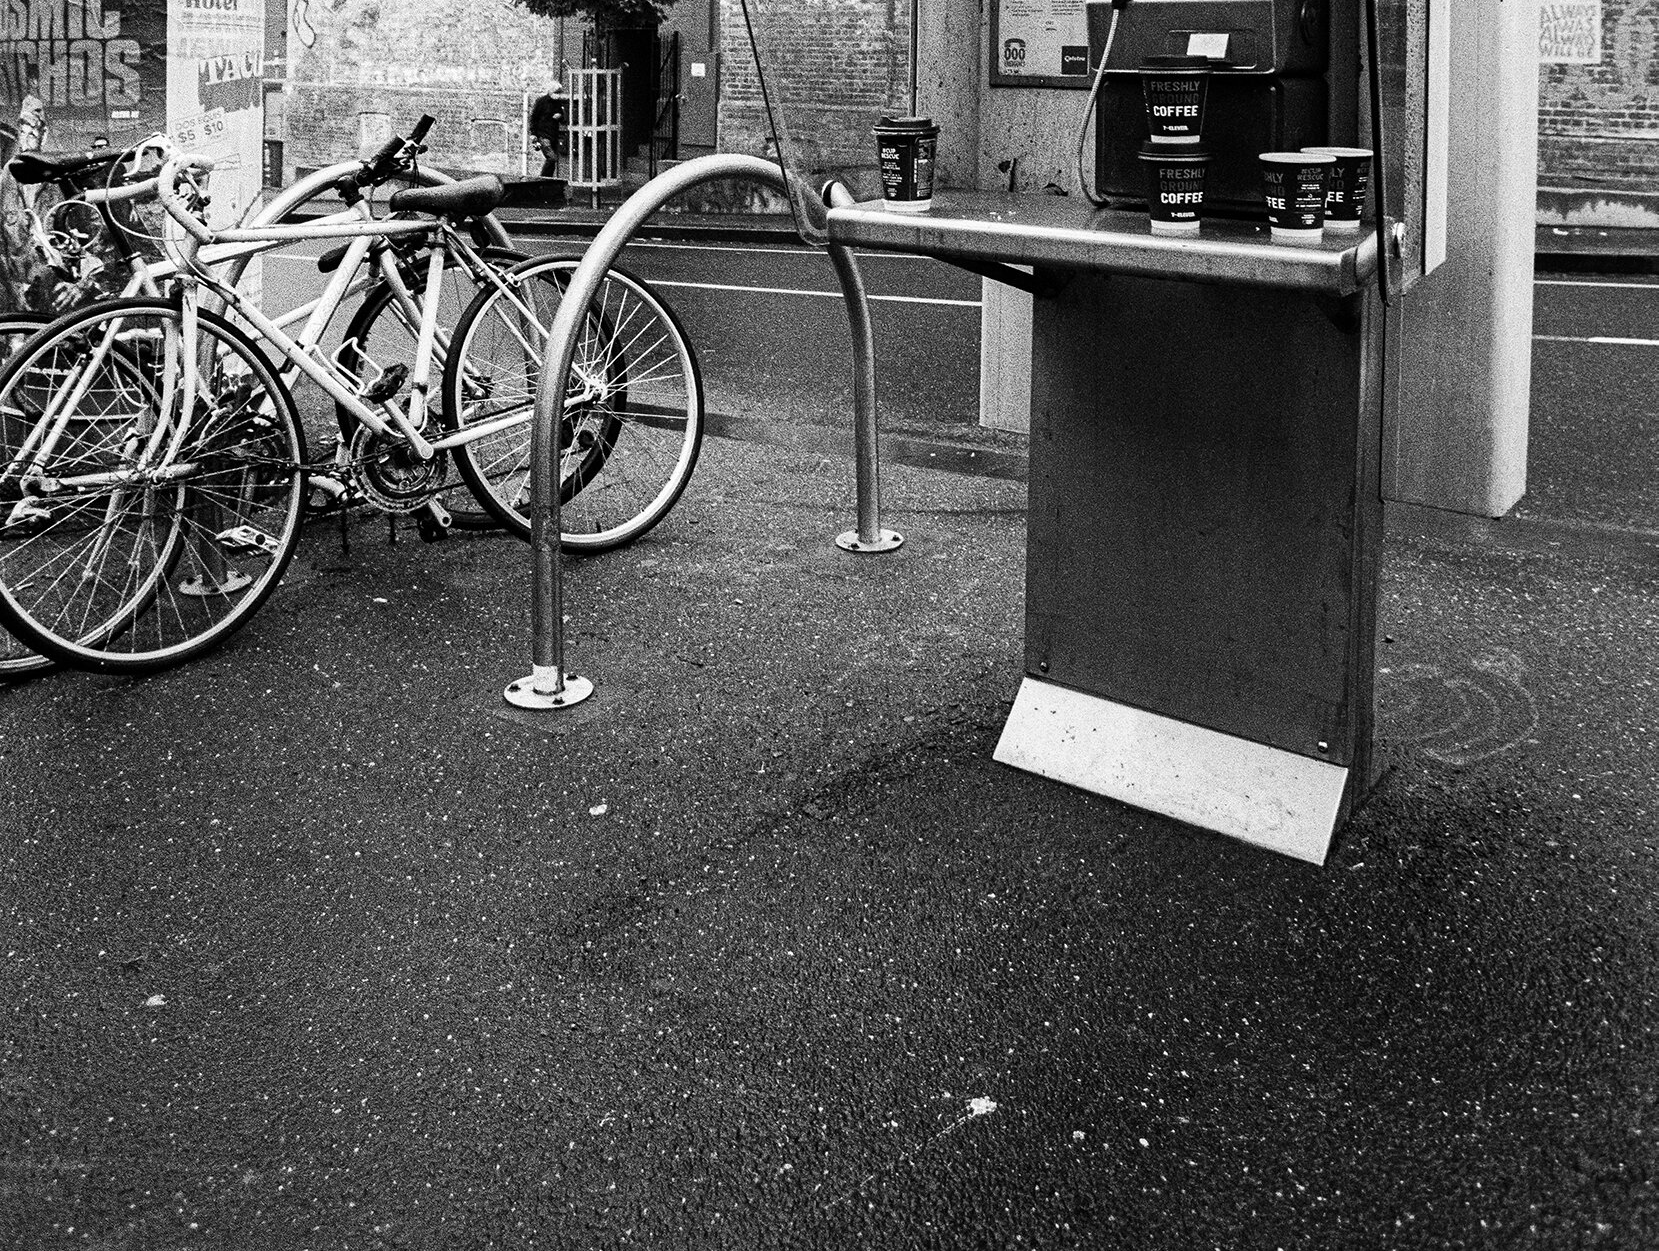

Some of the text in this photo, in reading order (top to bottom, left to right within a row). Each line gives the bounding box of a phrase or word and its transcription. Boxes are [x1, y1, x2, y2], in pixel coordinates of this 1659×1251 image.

[1004, 47, 1025, 60] 000
[1150, 81, 1200, 92] FRESHLY
[1152, 93, 1200, 104] GROUND
[1153, 105, 1199, 117] COFFEE
[177, 129, 196, 143] $5
[204, 120, 224, 136] $10
[1160, 192, 1204, 204] COFFEE
